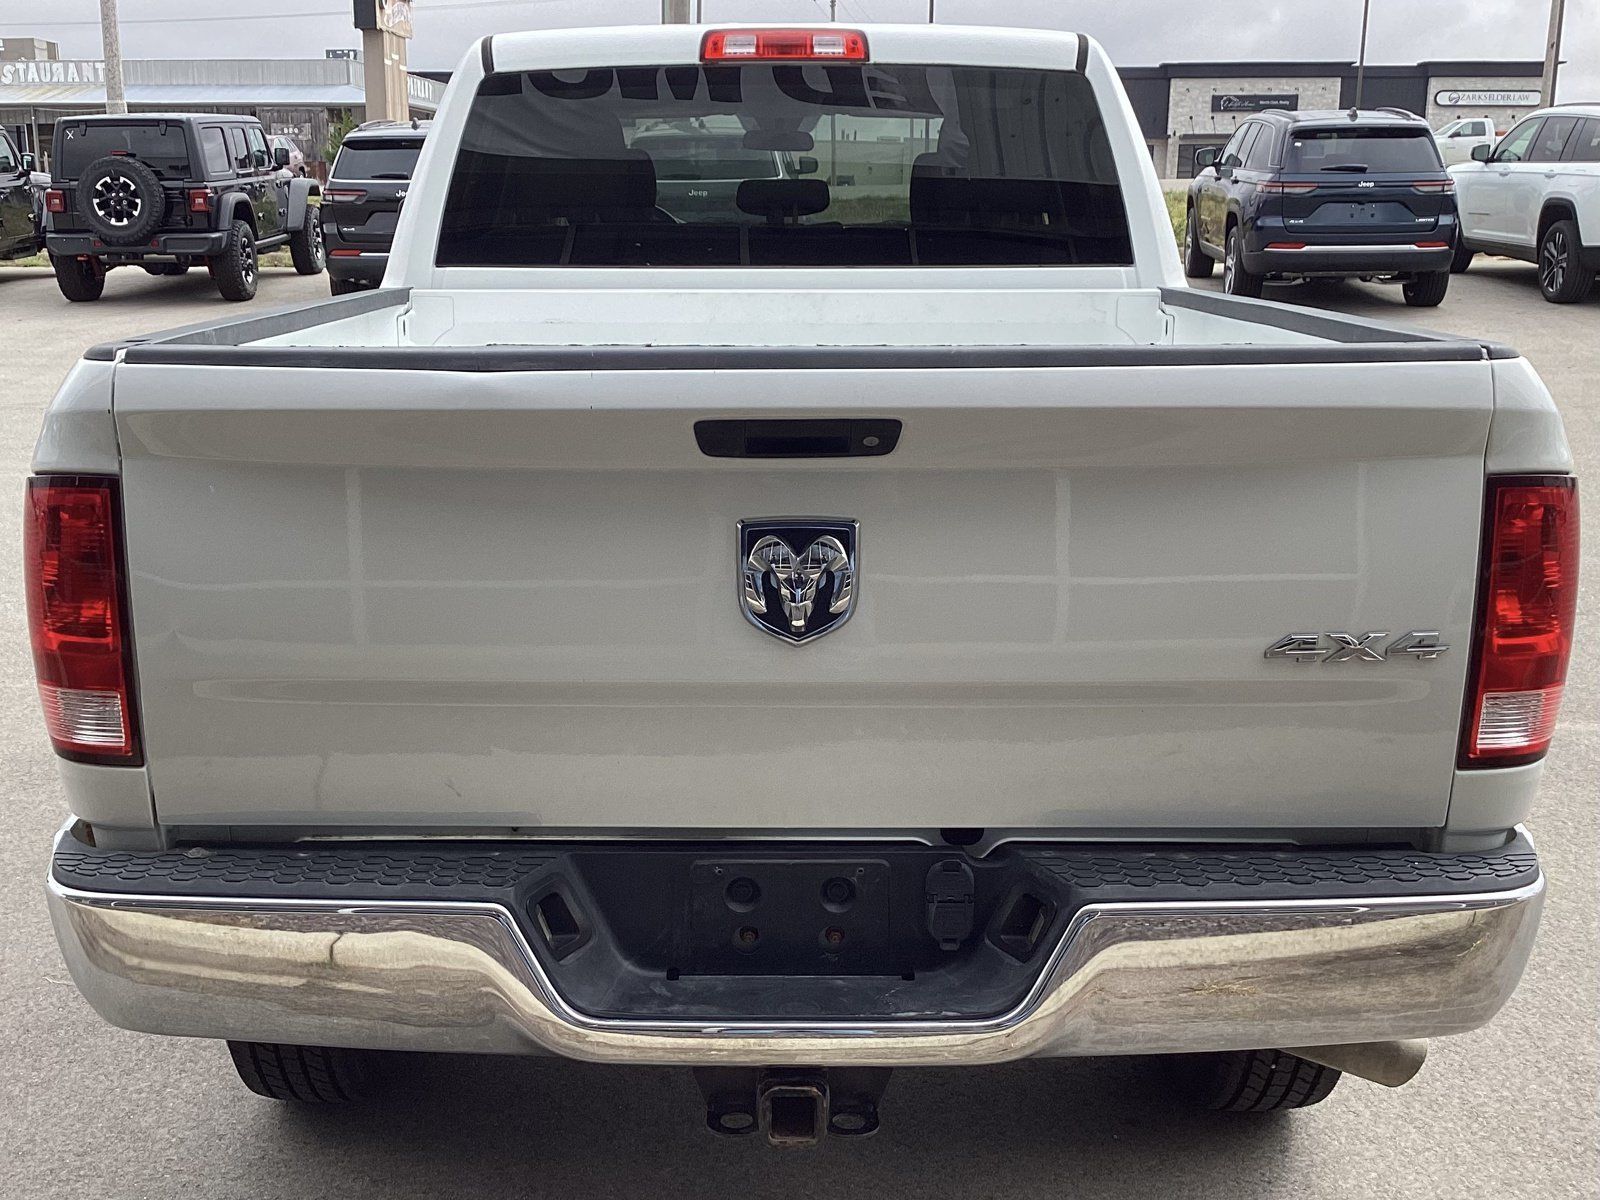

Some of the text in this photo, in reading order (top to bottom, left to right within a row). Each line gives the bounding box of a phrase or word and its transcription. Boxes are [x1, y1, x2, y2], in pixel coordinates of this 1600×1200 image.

[1358, 180, 1375, 188] Jeep
[395, 189, 408, 197] Je
[688, 189, 708, 197] Jeep
